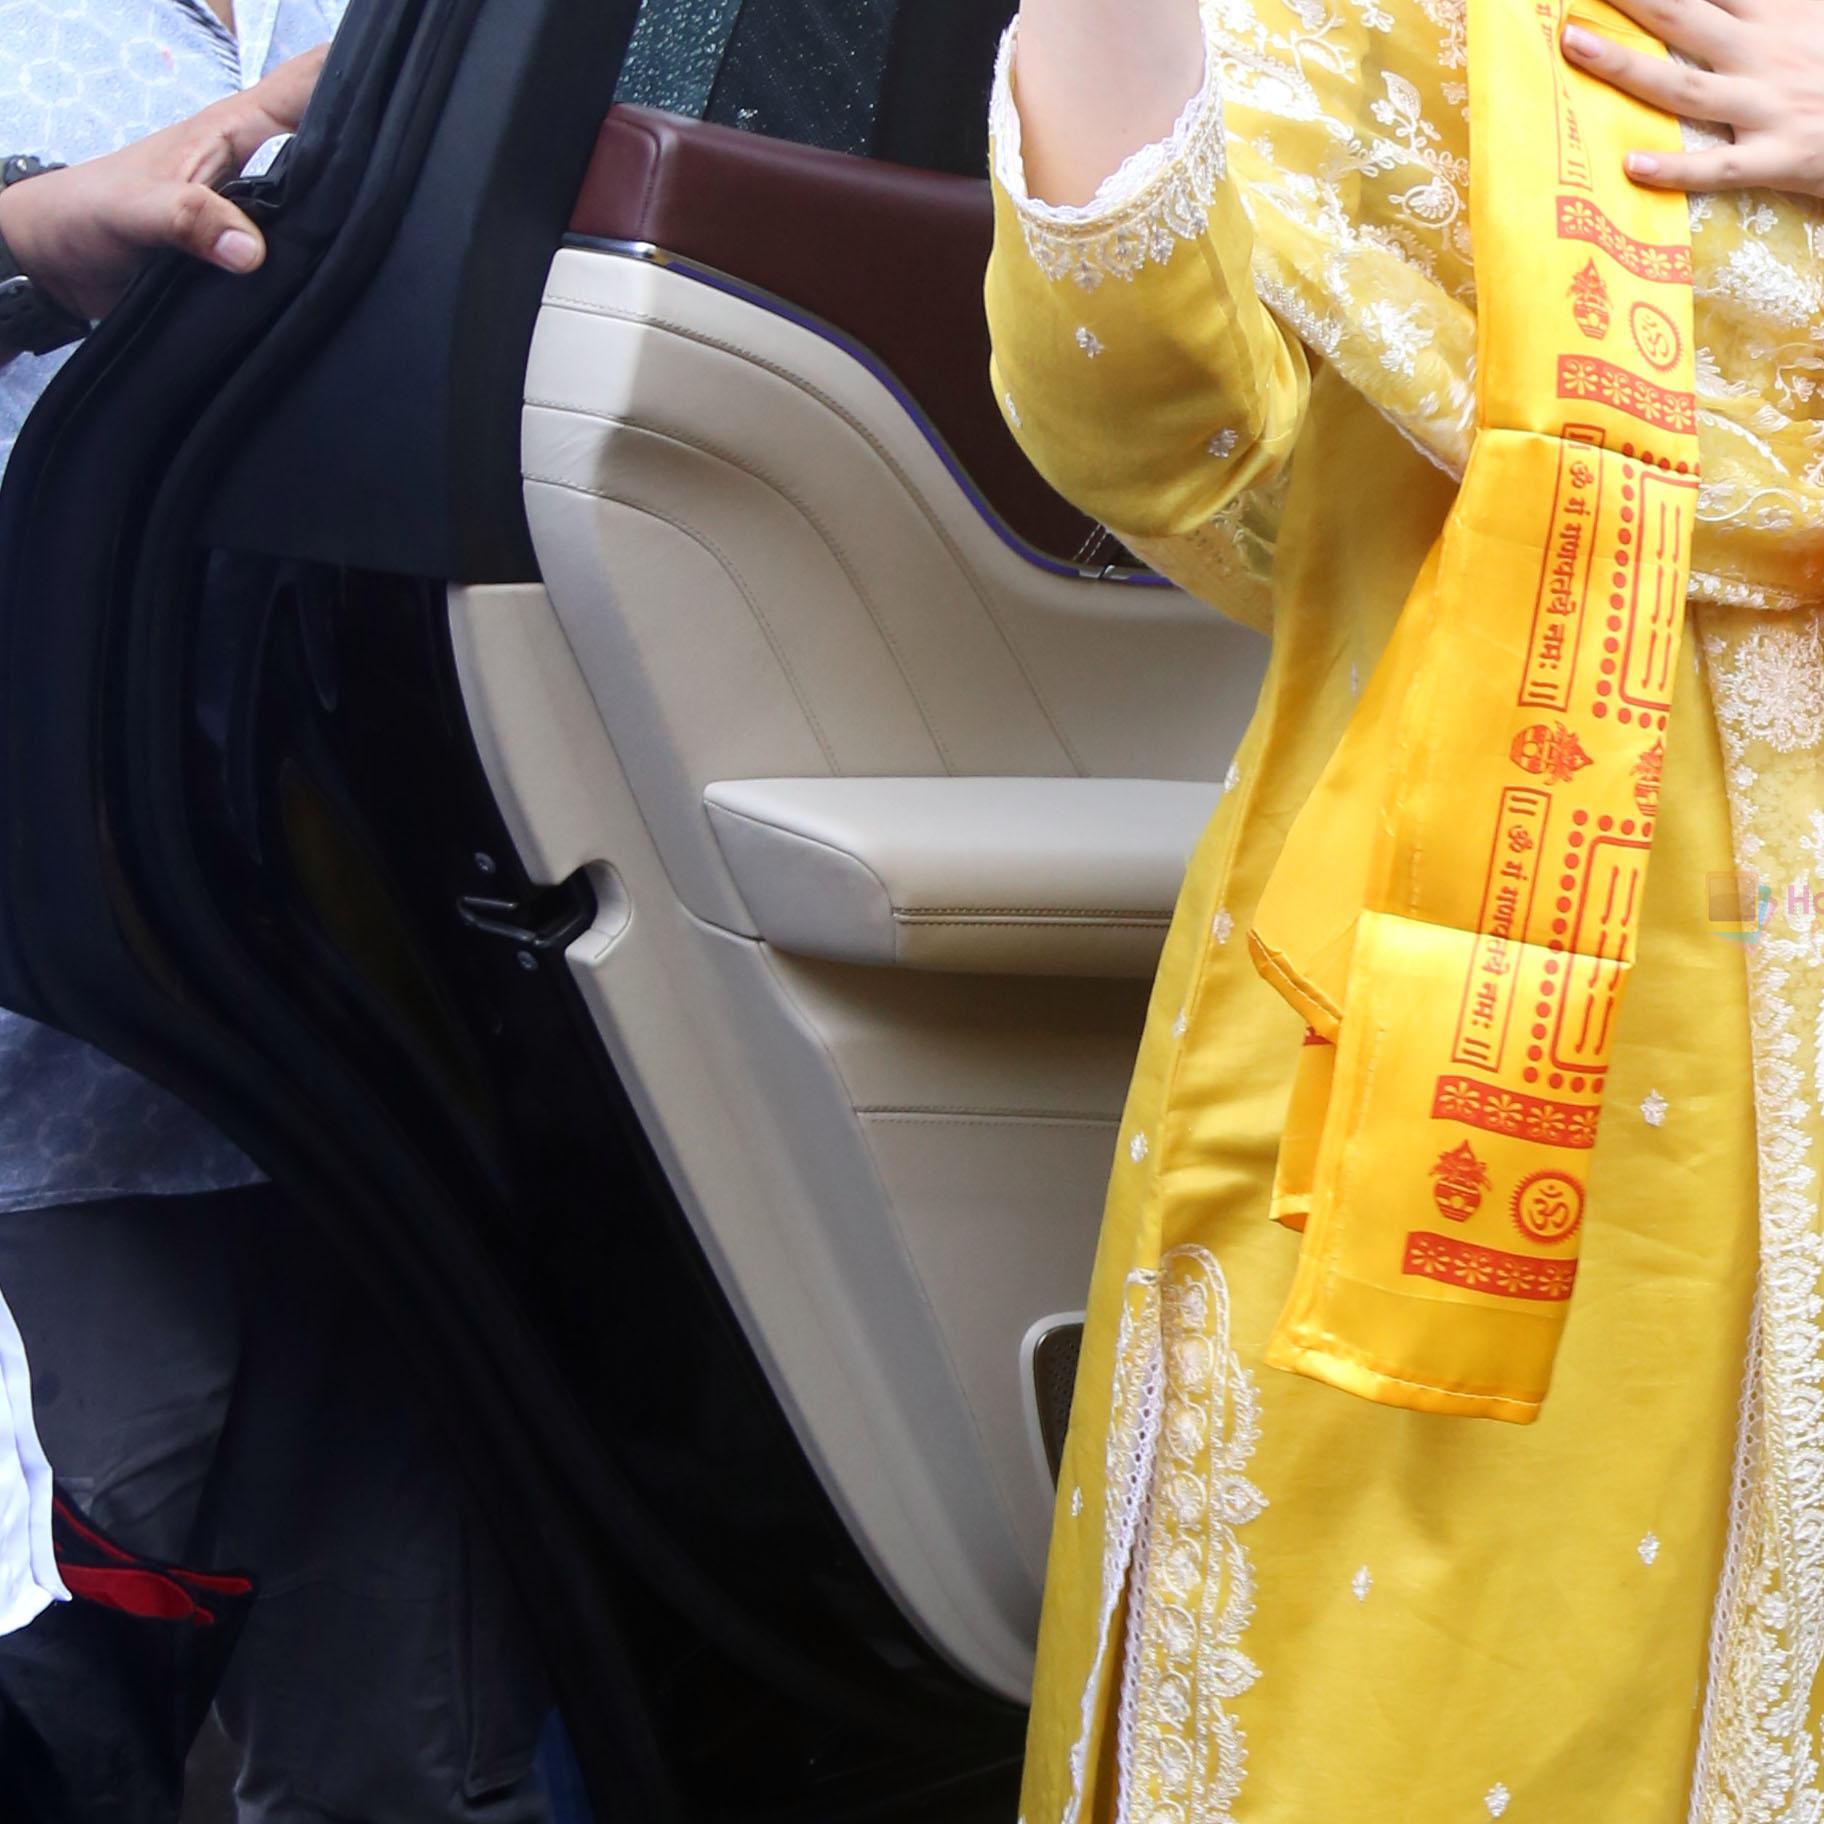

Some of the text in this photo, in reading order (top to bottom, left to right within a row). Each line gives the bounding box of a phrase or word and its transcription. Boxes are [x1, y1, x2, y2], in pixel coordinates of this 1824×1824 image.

[1569, 460, 1595, 489] ॐ
[1563, 496, 1592, 517] गं
[1546, 522, 1582, 616] गणपतये
[1507, 824, 1535, 854] ॐ
[1499, 859, 1530, 883] गं
[1481, 885, 1519, 976] गणपतये
